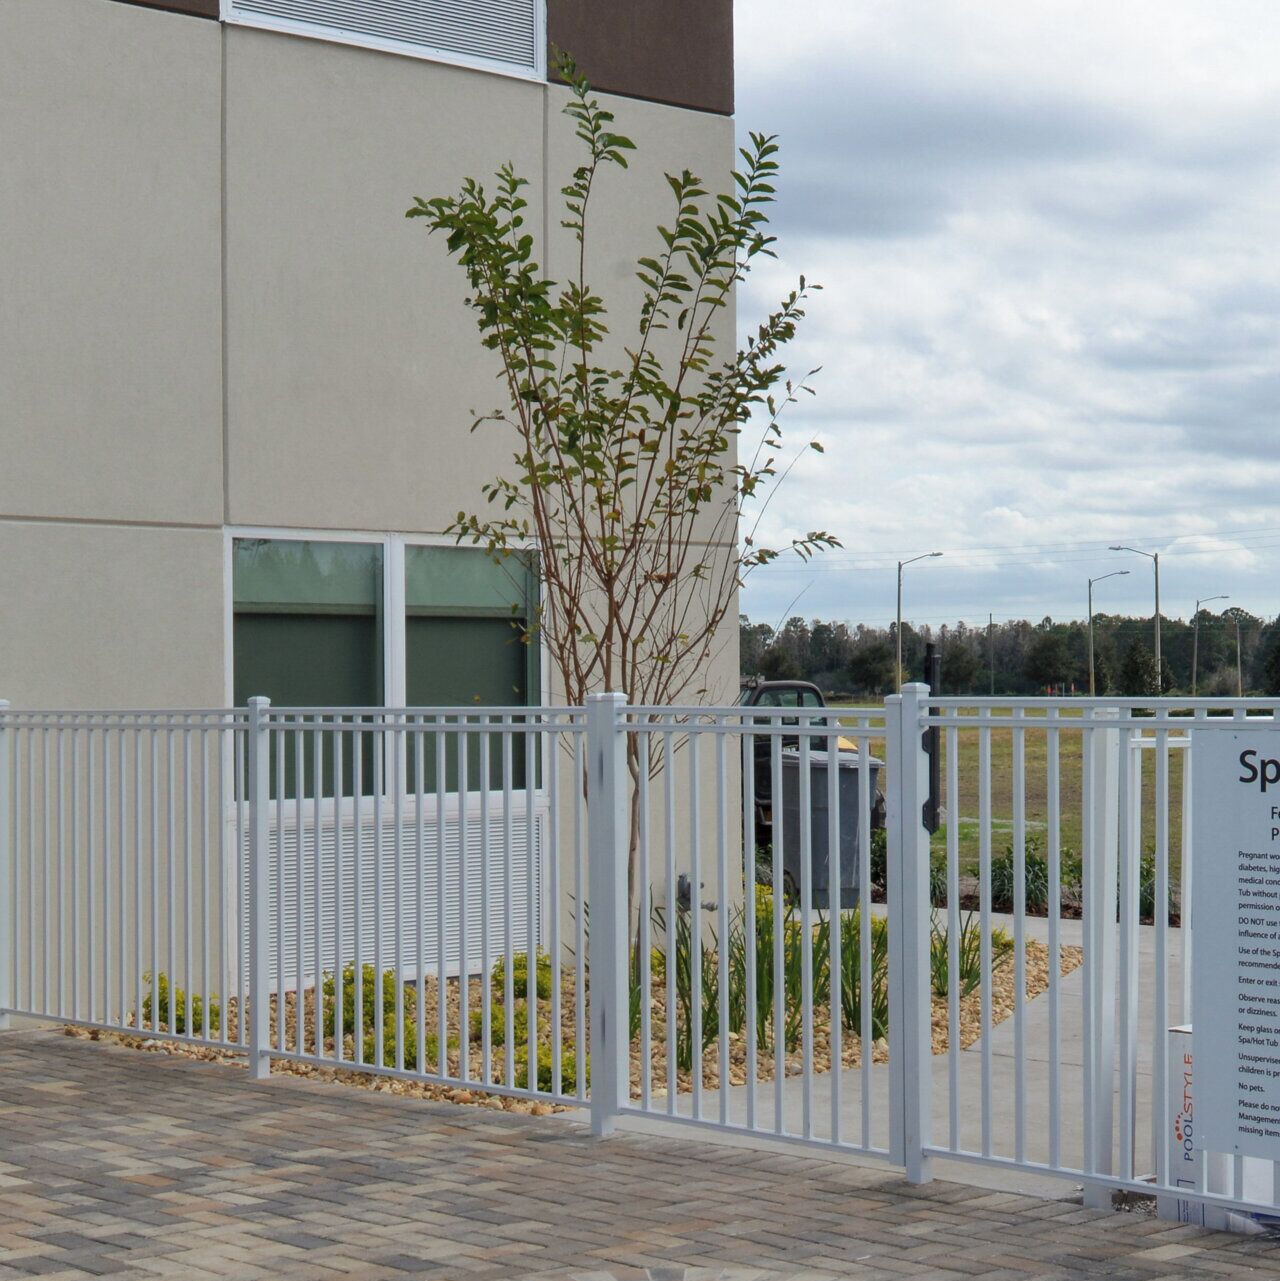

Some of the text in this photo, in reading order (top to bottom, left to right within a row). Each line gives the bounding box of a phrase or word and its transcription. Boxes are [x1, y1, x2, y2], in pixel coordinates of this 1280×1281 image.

[1238, 851, 1268, 860] Pregnant
[1238, 864, 1268, 872] diabetes,
[1252, 890, 1277, 898] without
[1238, 930, 1268, 938] influence
[1238, 976, 1255, 984] Enter
[1238, 994, 1265, 1003] Observe
[1247, 1007, 1277, 1016] dizziness.
[1238, 1023, 1255, 1032] Keep
[1256, 1025, 1272, 1034] glass
[1238, 1036, 1264, 1045] Spa/Hot
[1266, 1039, 1278, 1047] Tub
[1238, 1065, 1264, 1074] children
[1239, 1082, 1248, 1090] No
[1238, 1100, 1259, 1109] Please
[1239, 1126, 1263, 1136] missing
